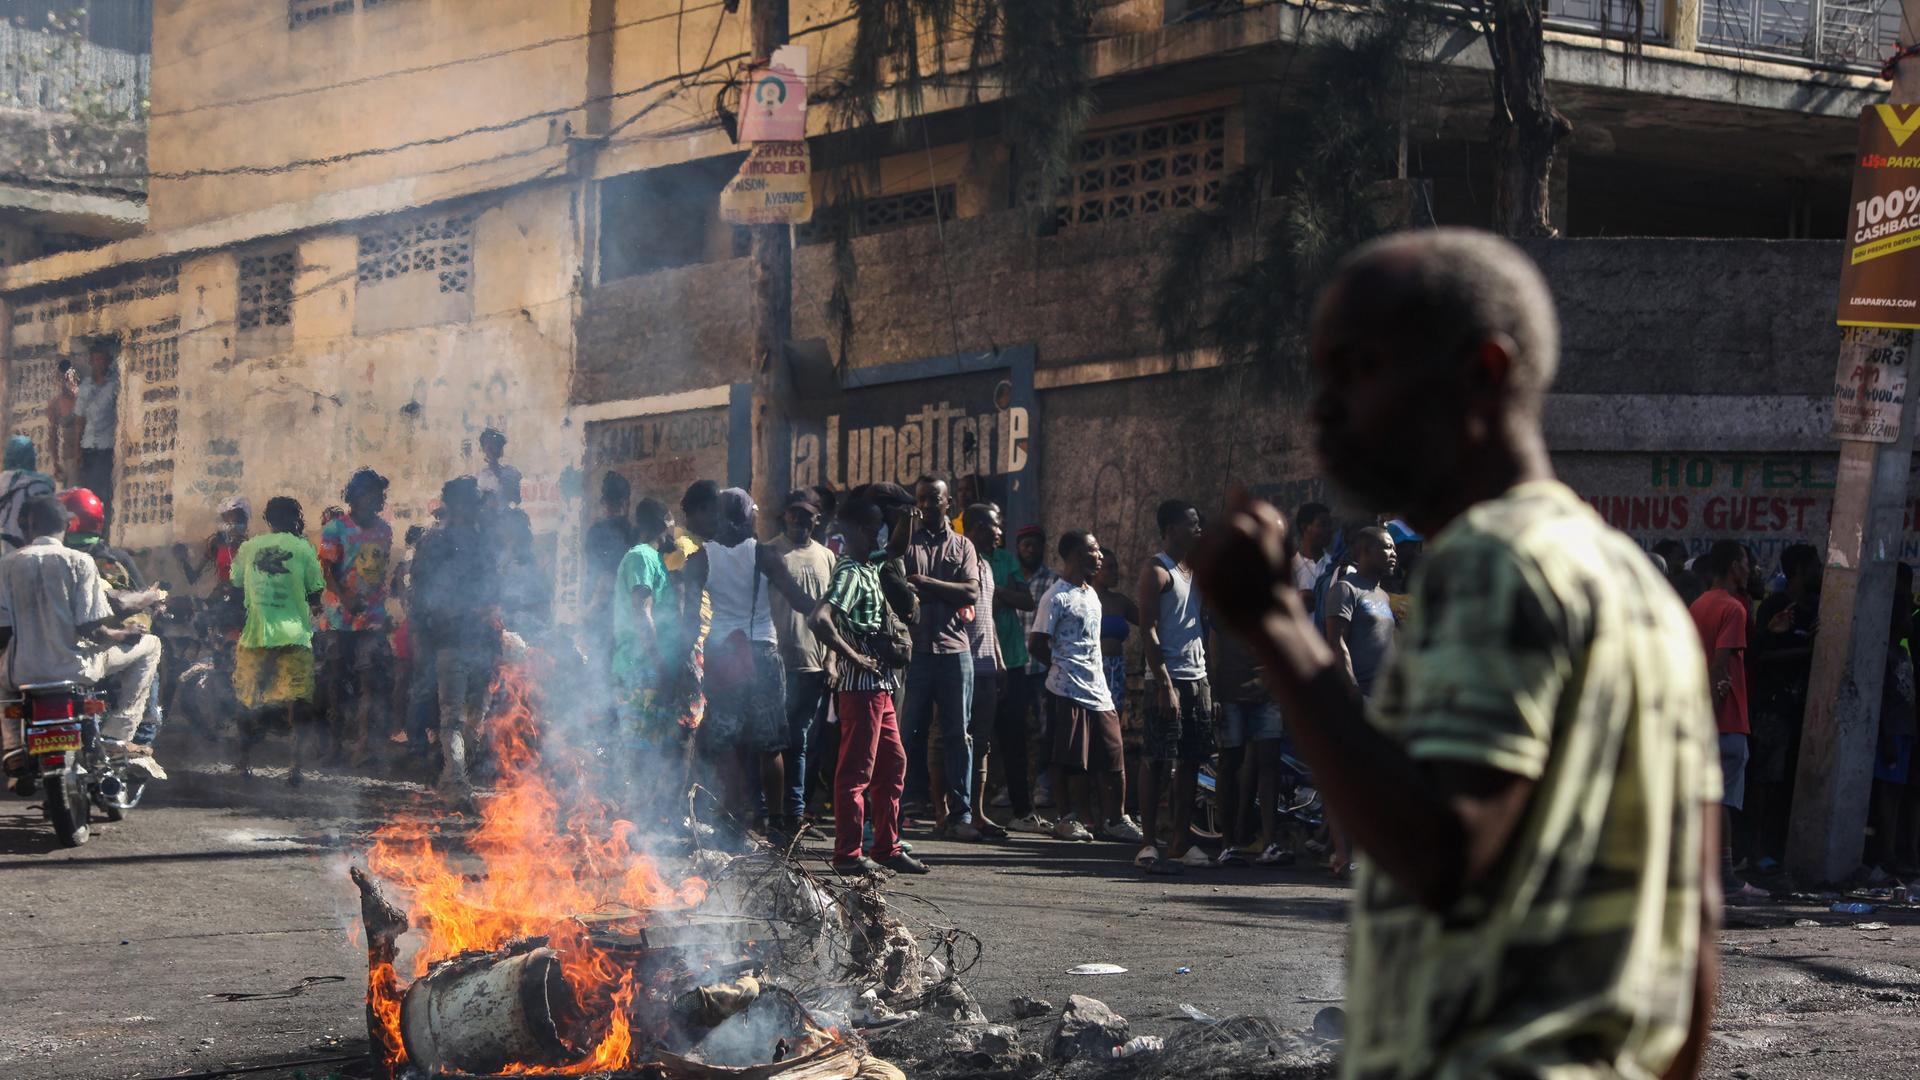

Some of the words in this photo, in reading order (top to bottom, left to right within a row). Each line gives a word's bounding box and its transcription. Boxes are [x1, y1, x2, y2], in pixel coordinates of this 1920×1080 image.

[1854, 213, 1920, 244] CASHBAC
[1652, 456, 1837, 488] HOTEL
[1703, 496, 1816, 532] GUEST
